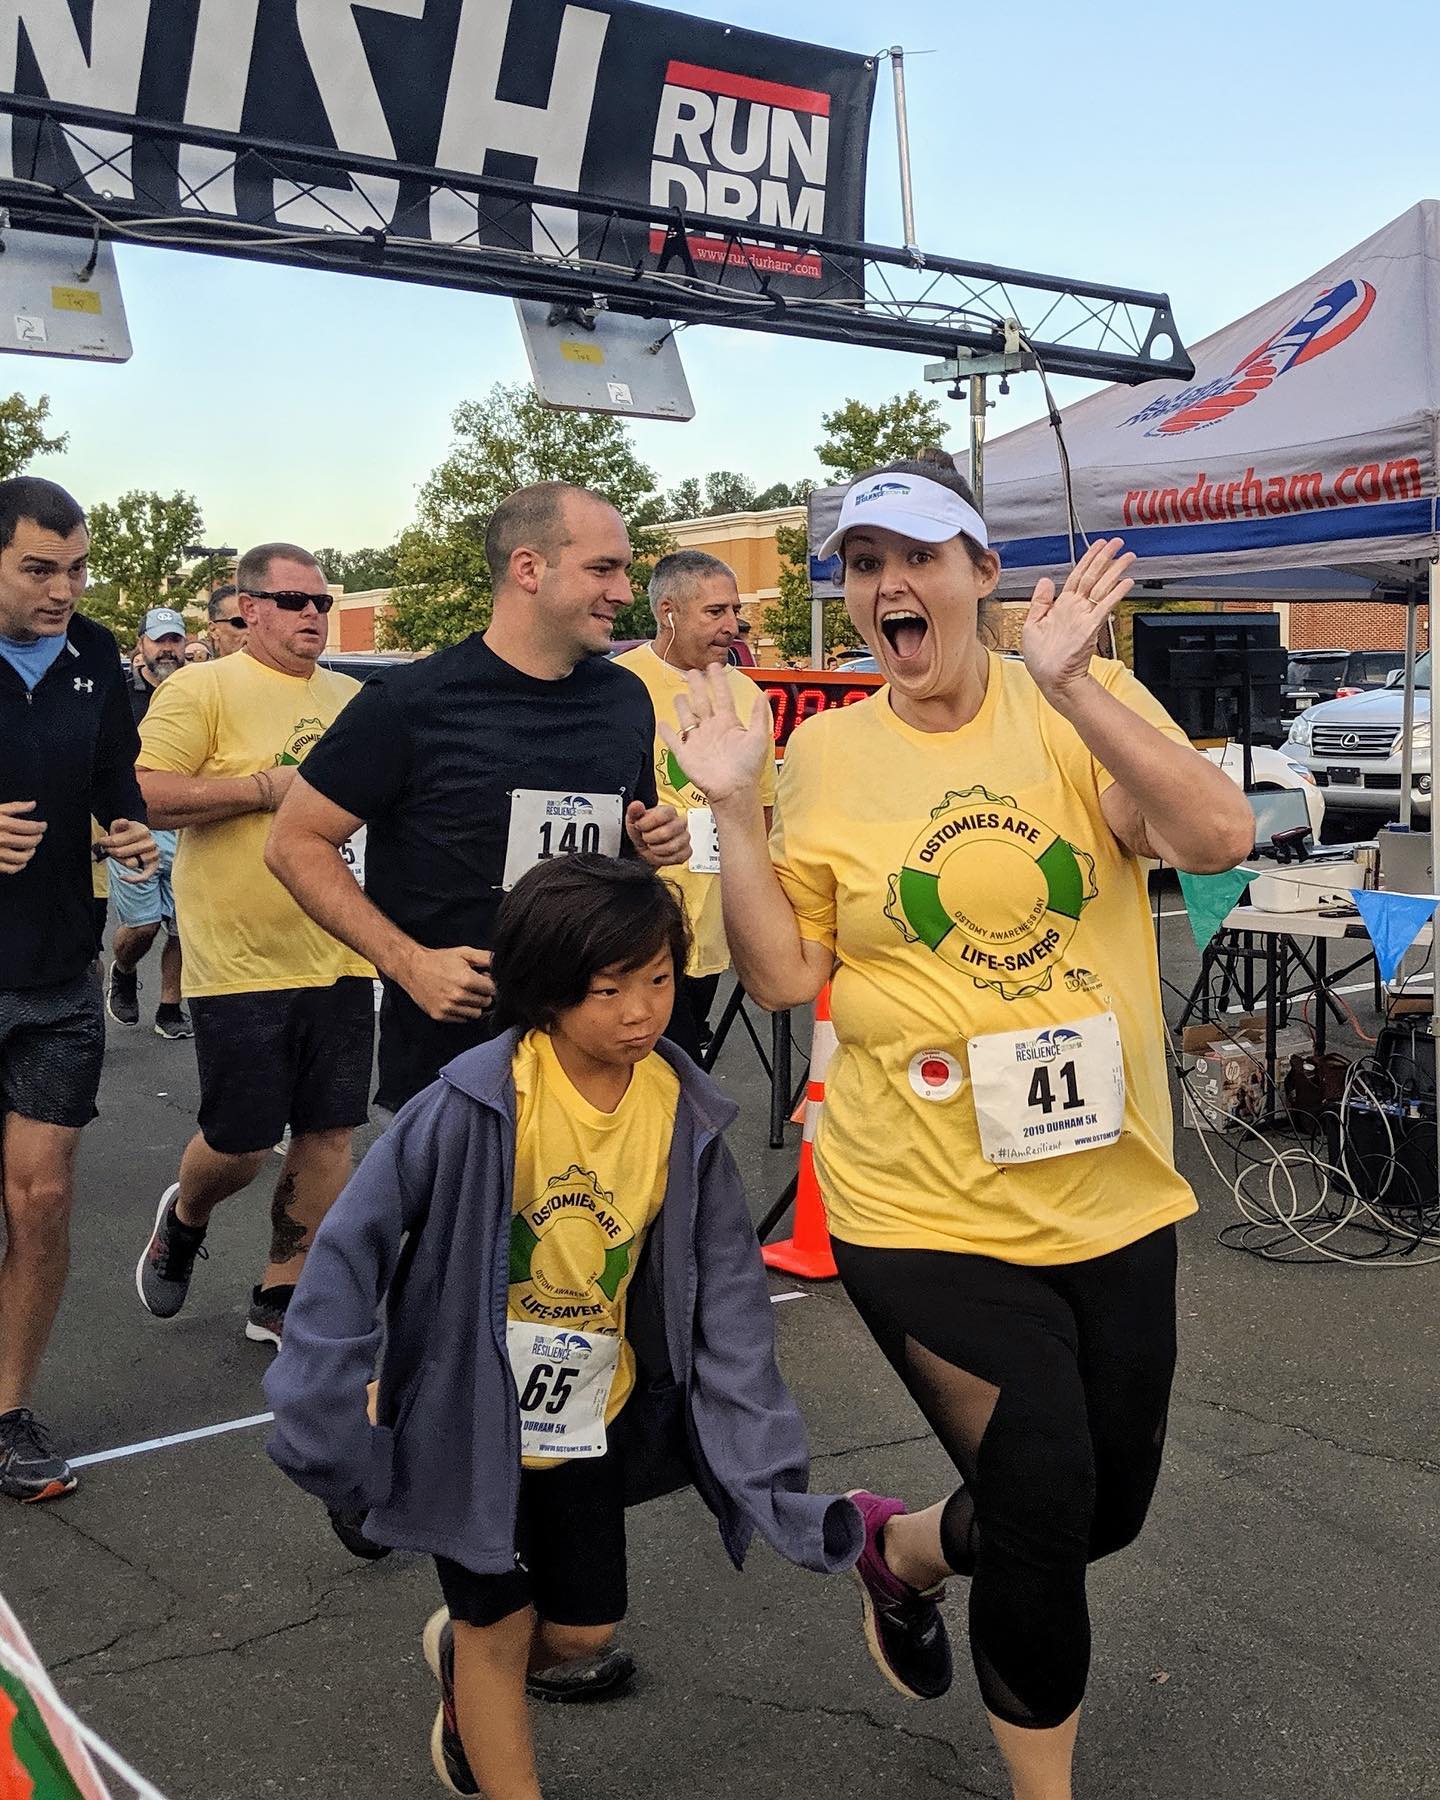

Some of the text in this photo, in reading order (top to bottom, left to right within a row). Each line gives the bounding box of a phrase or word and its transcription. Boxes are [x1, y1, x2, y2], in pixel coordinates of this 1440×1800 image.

[652, 83, 830, 186] RUN
[650, 159, 826, 257] DRM
[1123, 457, 1422, 527] rundurham.com
[292, 733, 321, 755] OSTOMIE
[538, 821, 600, 859] 140
[919, 813, 1041, 863] OSTOMIES ARE
[954, 896, 1045, 940] OSTOMY AWARENESS DAY
[960, 928, 1060, 971] LIFE-SAVERS
[1016, 1044, 1062, 1062] RESILIENCE
[1028, 1060, 1085, 1115] 41
[1023, 1113, 1098, 1138] 2019 DURHAM 5K
[998, 1140, 1062, 1158] #IAmResilient
[595, 1210, 622, 1239] ARE
[586, 1271, 598, 1285] DAY
[520, 1294, 603, 1320] LIFE-SAVER
[532, 1343, 572, 1360] RESILIENCE
[520, 1364, 580, 1414] 65
[523, 1420, 554, 1433] DURHAM
[555, 1424, 567, 1434] 5K
